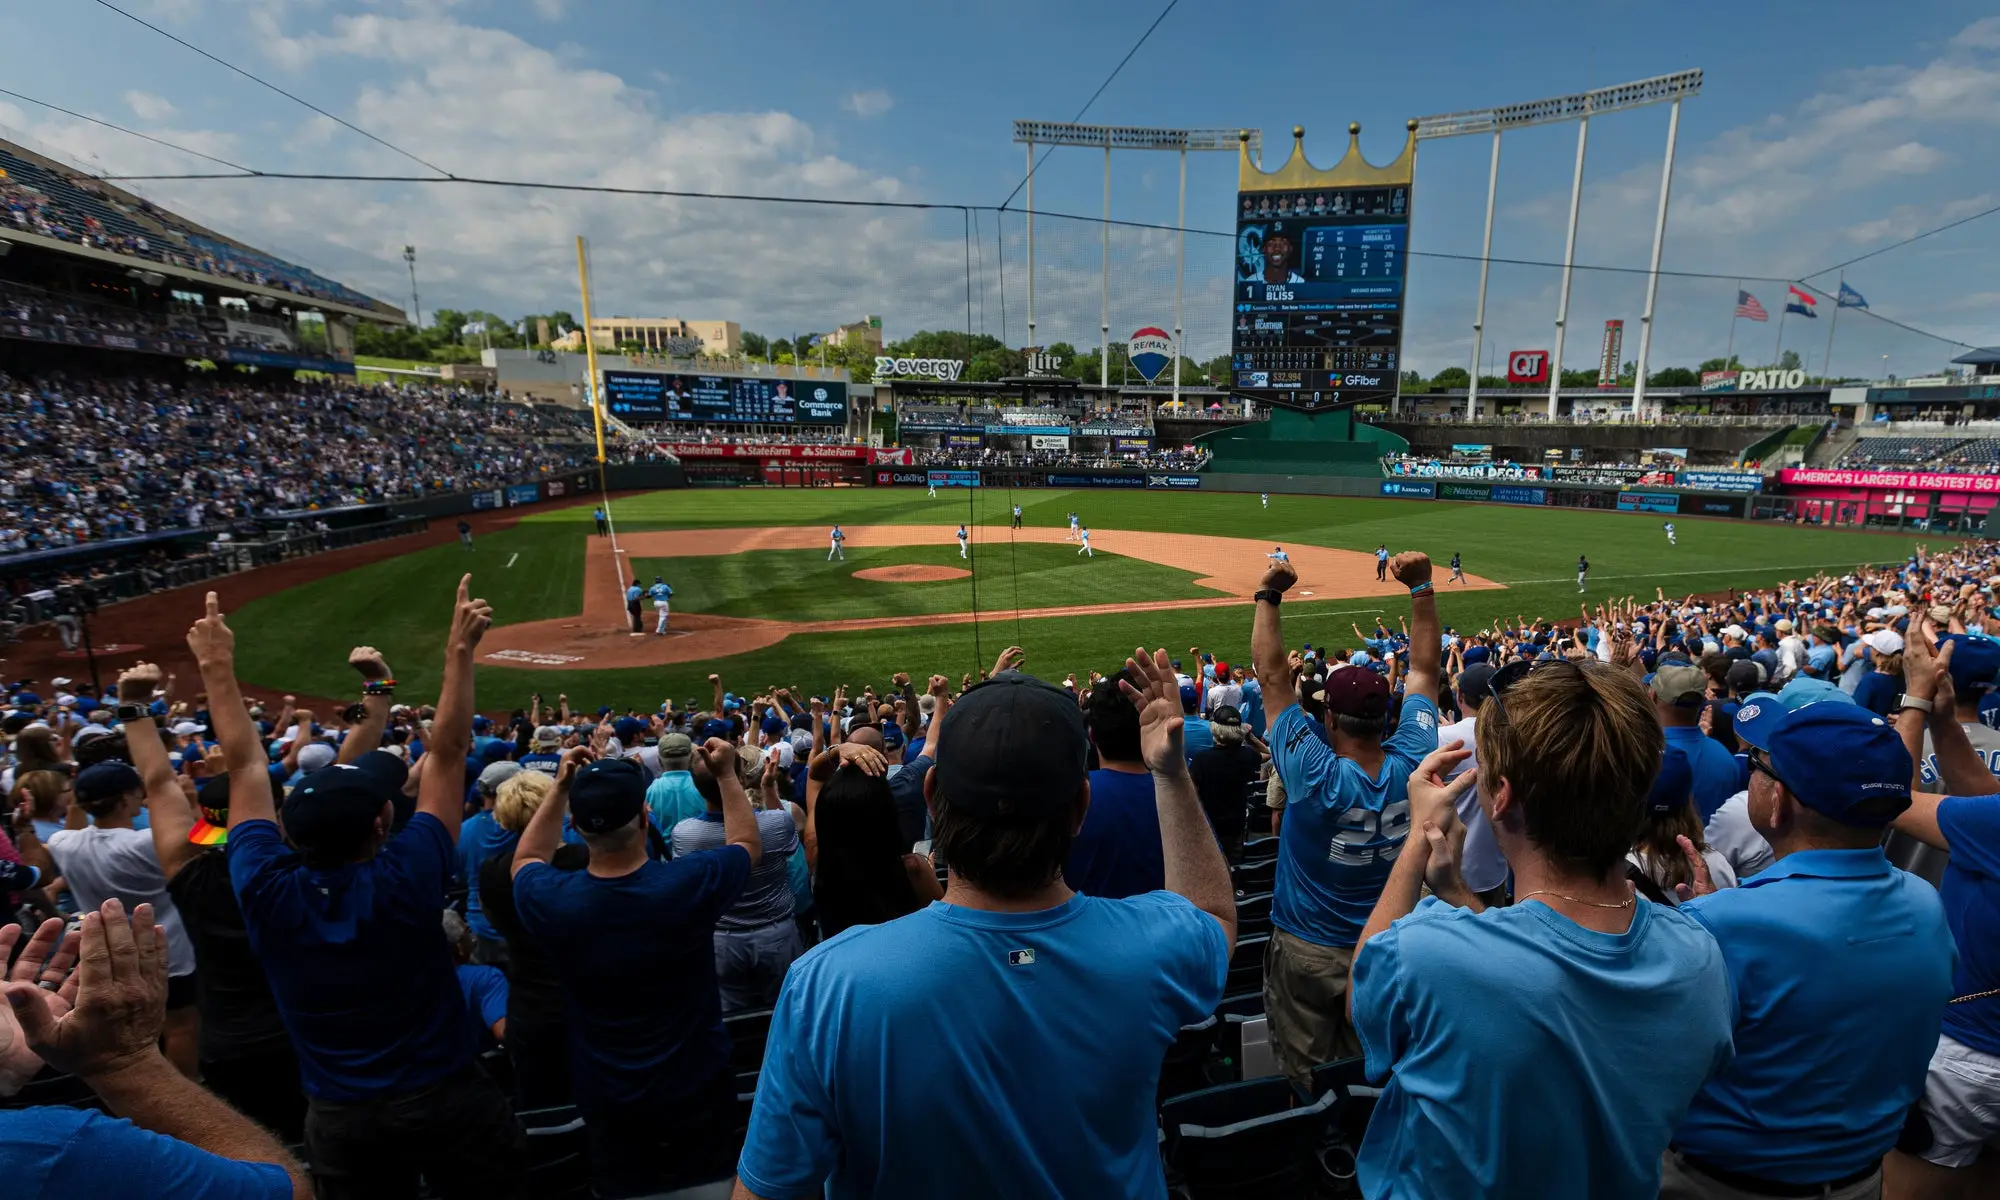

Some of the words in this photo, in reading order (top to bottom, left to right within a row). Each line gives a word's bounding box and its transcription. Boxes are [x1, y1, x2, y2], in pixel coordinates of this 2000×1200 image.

[1246, 285, 1253, 299] 1
[1266, 291, 1294, 301] BLISS
[1134, 340, 1168, 351] RE/MAX
[1030, 352, 1062, 373] Lite
[1512, 354, 1544, 377] QT
[896, 359, 962, 380] evergy
[1345, 375, 1381, 386] GFiber
[1701, 378, 1736, 392] CHOPPER
[1738, 369, 1805, 390] PATIO
[1291, 391, 1295, 402] 1
[1314, 391, 1320, 402] 0
[1333, 391, 1339, 402] 2
[798, 400, 843, 409] Commerce
[811, 408, 832, 417] Bank
[677, 446, 699, 455] State
[701, 447, 722, 456] Farm
[747, 447, 768, 456] State
[770, 447, 791, 456] Farm
[814, 447, 834, 456] State
[835, 448, 856, 457] Farm
[878, 454, 901, 462] SONIC
[1417, 465, 1484, 477] FOUNTAIN
[1488, 467, 1525, 478] DECK
[878, 474, 890, 482] QT
[893, 474, 925, 483] QuikTrip
[1792, 471, 1853, 484] AMERICA'S
[1854, 472, 1906, 486] LARGEST
[1908, 475, 1917, 486] &
[1919, 477, 1973, 489] FASTEST
[1974, 478, 1993, 490] 5G
[1453, 486, 1490, 496] National
[1643, 496, 1675, 505] CHOPPER
